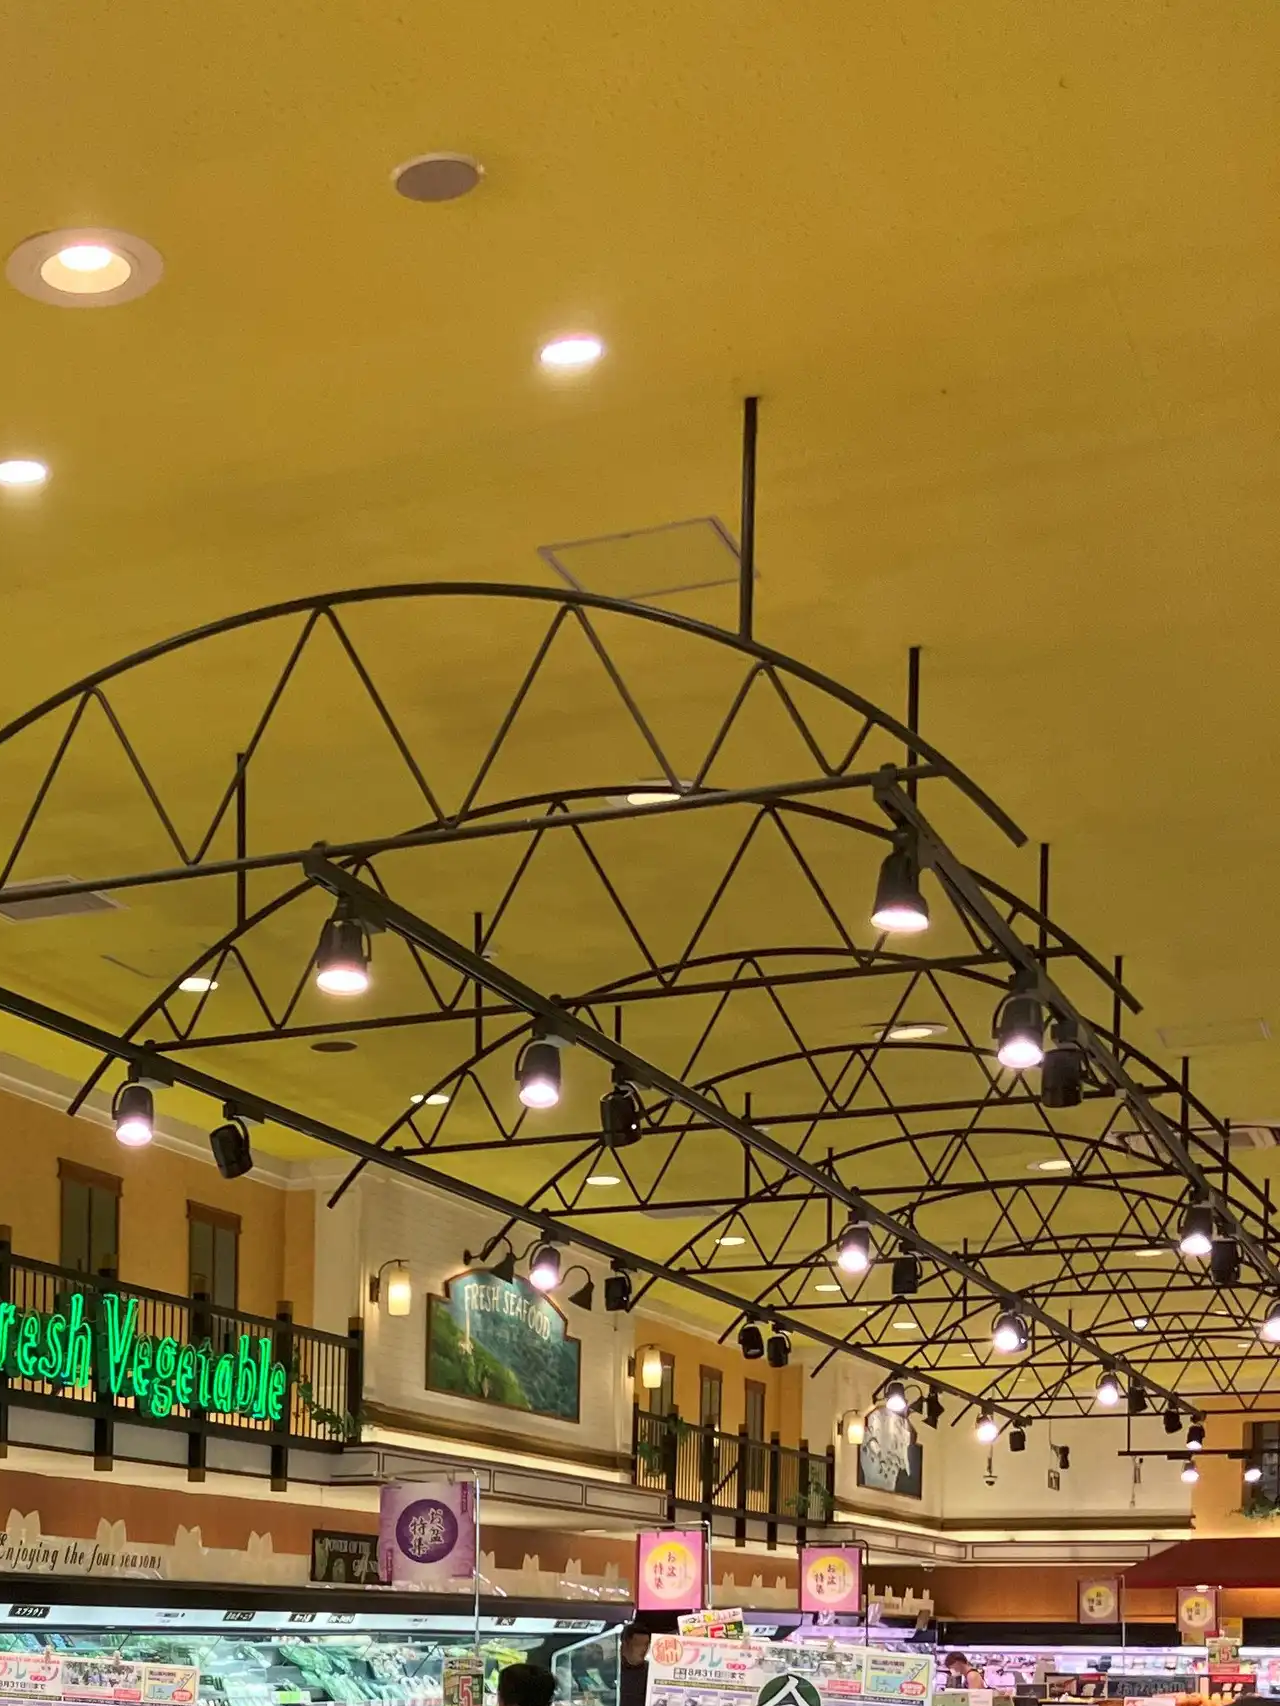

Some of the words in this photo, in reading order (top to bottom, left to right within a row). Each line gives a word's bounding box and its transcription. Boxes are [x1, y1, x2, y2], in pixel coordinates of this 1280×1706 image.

[104, 1293, 286, 1421] Vegetable
[409, 1516, 429, 1557] 特集
[427, 1508, 445, 1544] お盆
[64, 1543, 85, 1567] the
[87, 1544, 117, 1573] four
[120, 1552, 162, 1572] seasons
[15, 1606, 46, 1618] スプラウト
